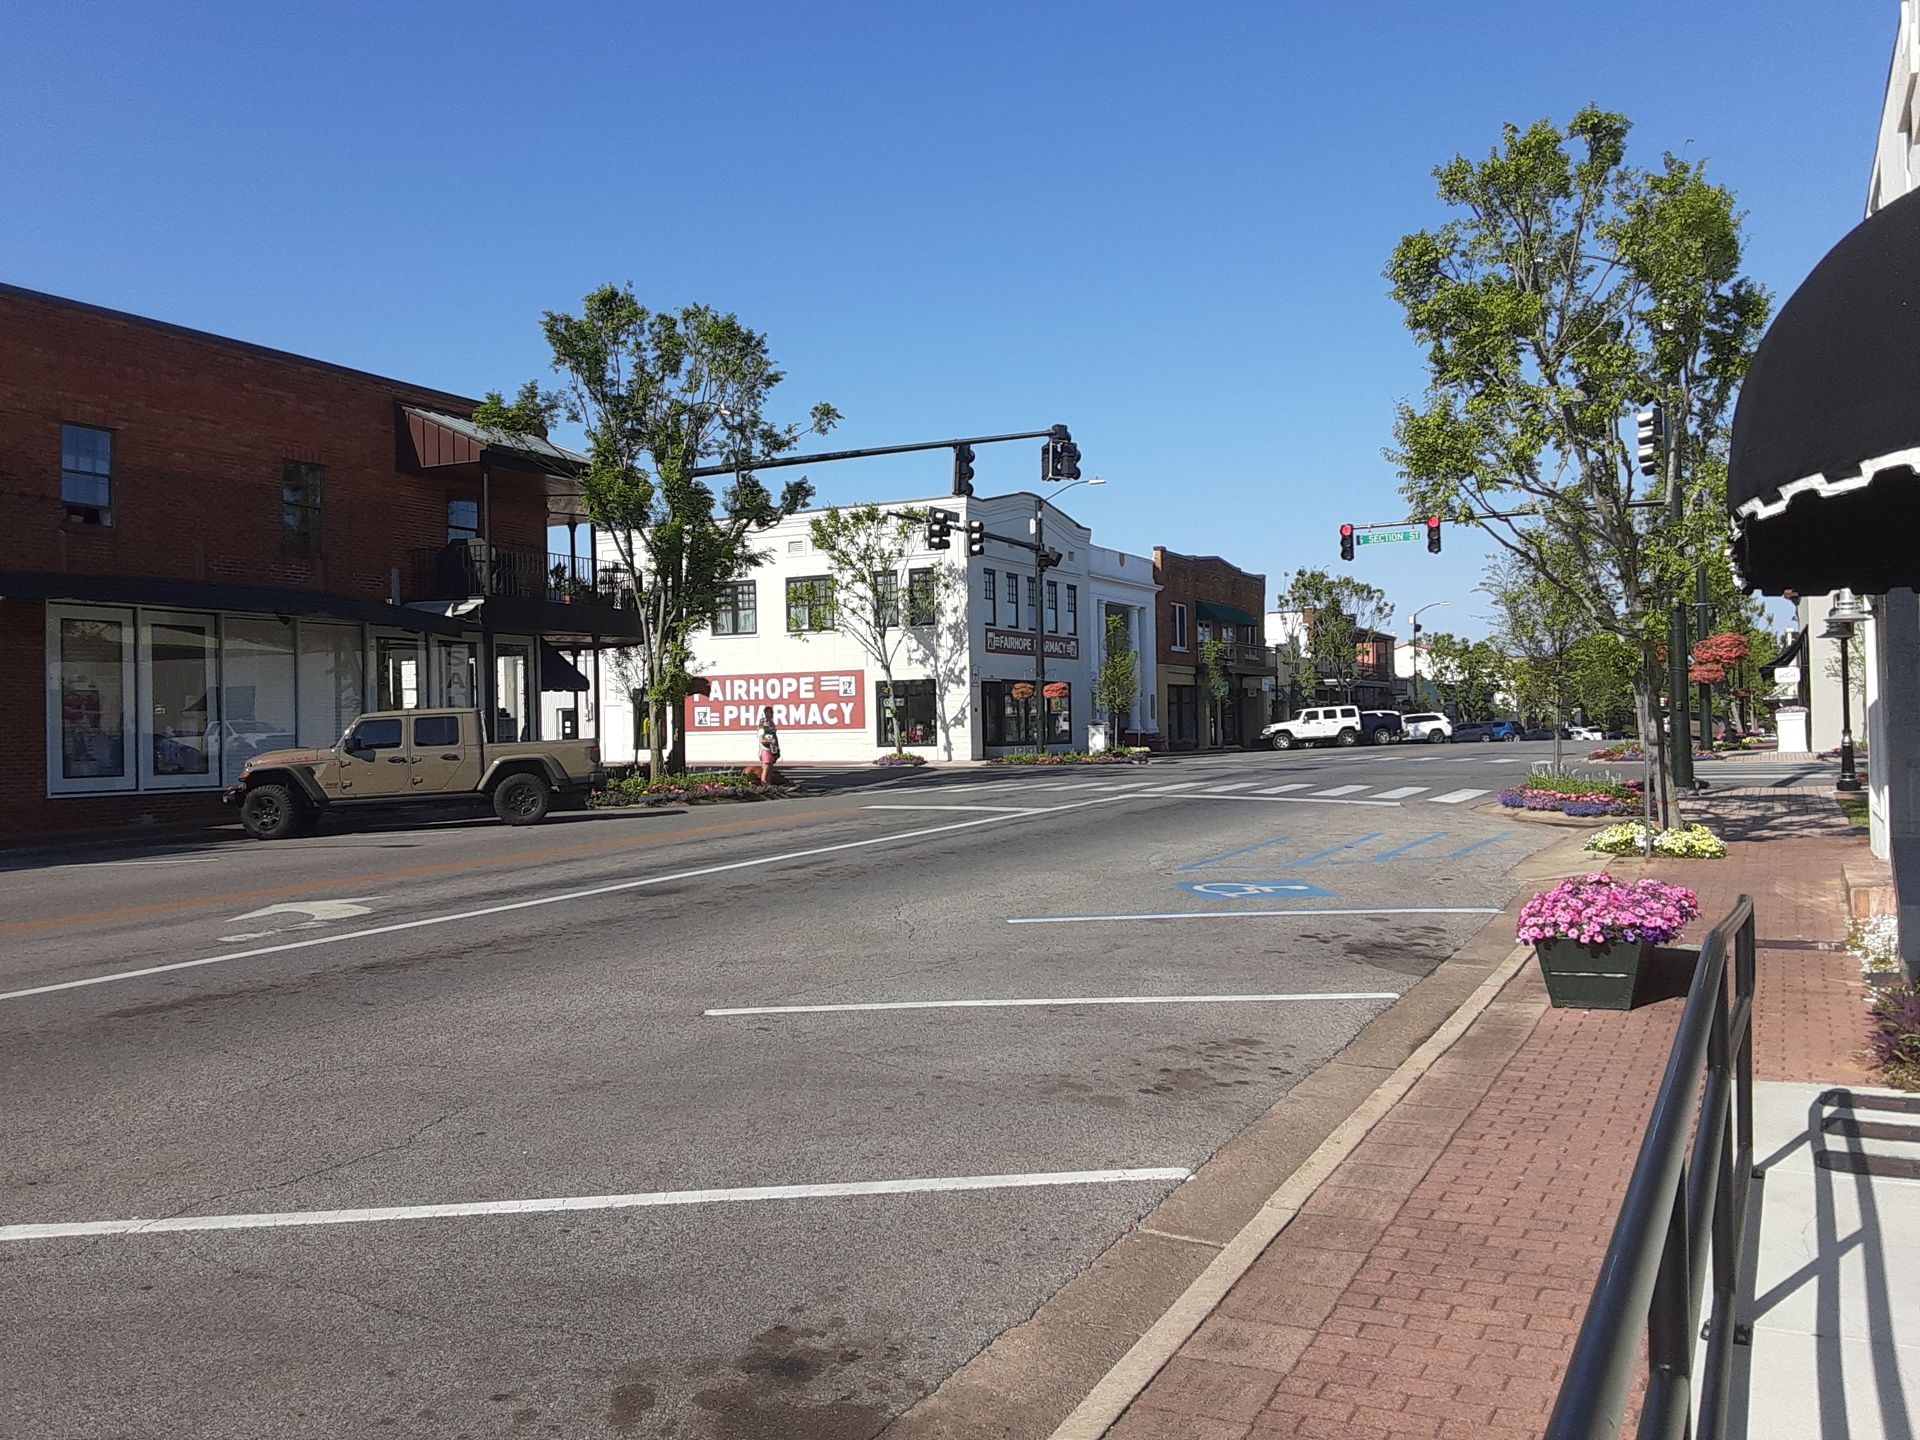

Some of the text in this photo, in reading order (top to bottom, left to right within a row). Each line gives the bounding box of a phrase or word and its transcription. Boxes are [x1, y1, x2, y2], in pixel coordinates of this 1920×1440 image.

[1368, 533, 1404, 543] SECTION
[1409, 531, 1420, 540] ST
[1000, 635, 1032, 651] FAIRHOPE
[1033, 639, 1067, 654] ARMACY
[693, 676, 815, 702] AIRHOPE
[723, 702, 855, 726] PHARMACY
